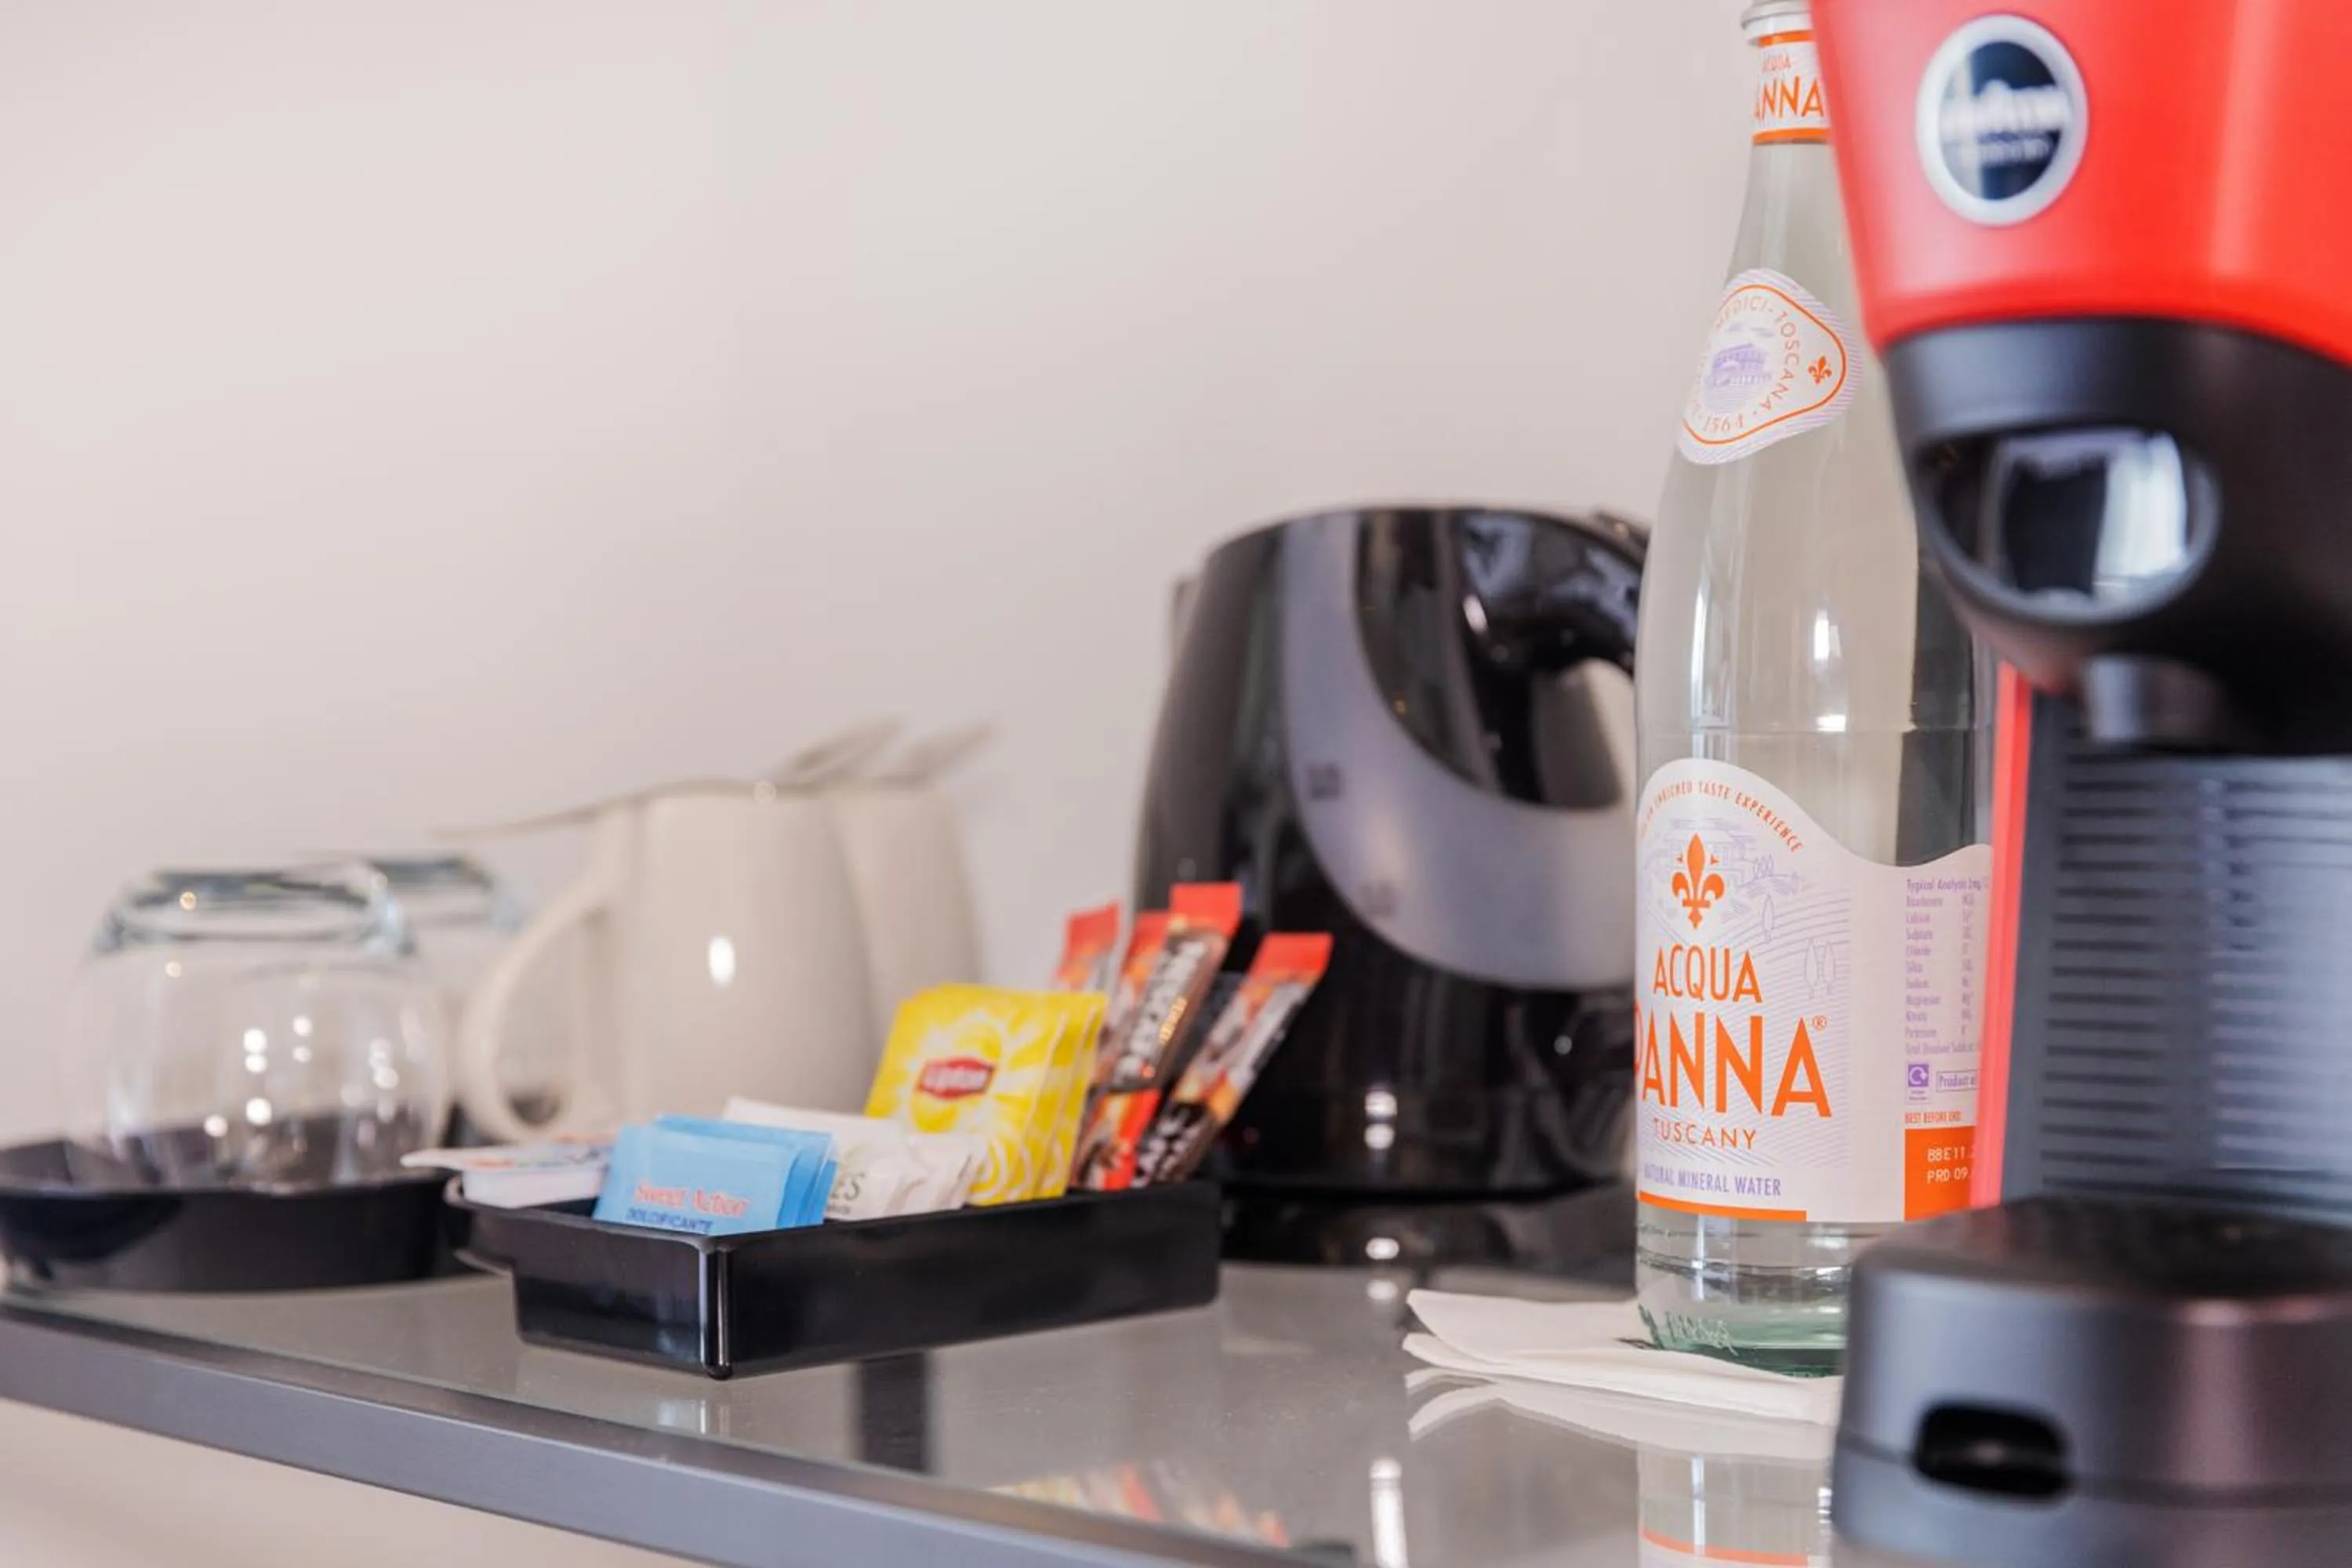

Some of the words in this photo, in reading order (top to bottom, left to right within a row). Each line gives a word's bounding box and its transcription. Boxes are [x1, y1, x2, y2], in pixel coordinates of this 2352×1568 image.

[1759, 311, 1801, 411] TOSCANA
[1697, 780, 1731, 800] TASTE
[1734, 790, 1804, 853] EXPERIENCE
[1653, 943, 1762, 1004] ACQUA
[1653, 1117, 1757, 1151] TUSCANY
[1677, 1167, 1730, 1194] MINERAL
[1735, 1175, 1782, 1196] WATER
